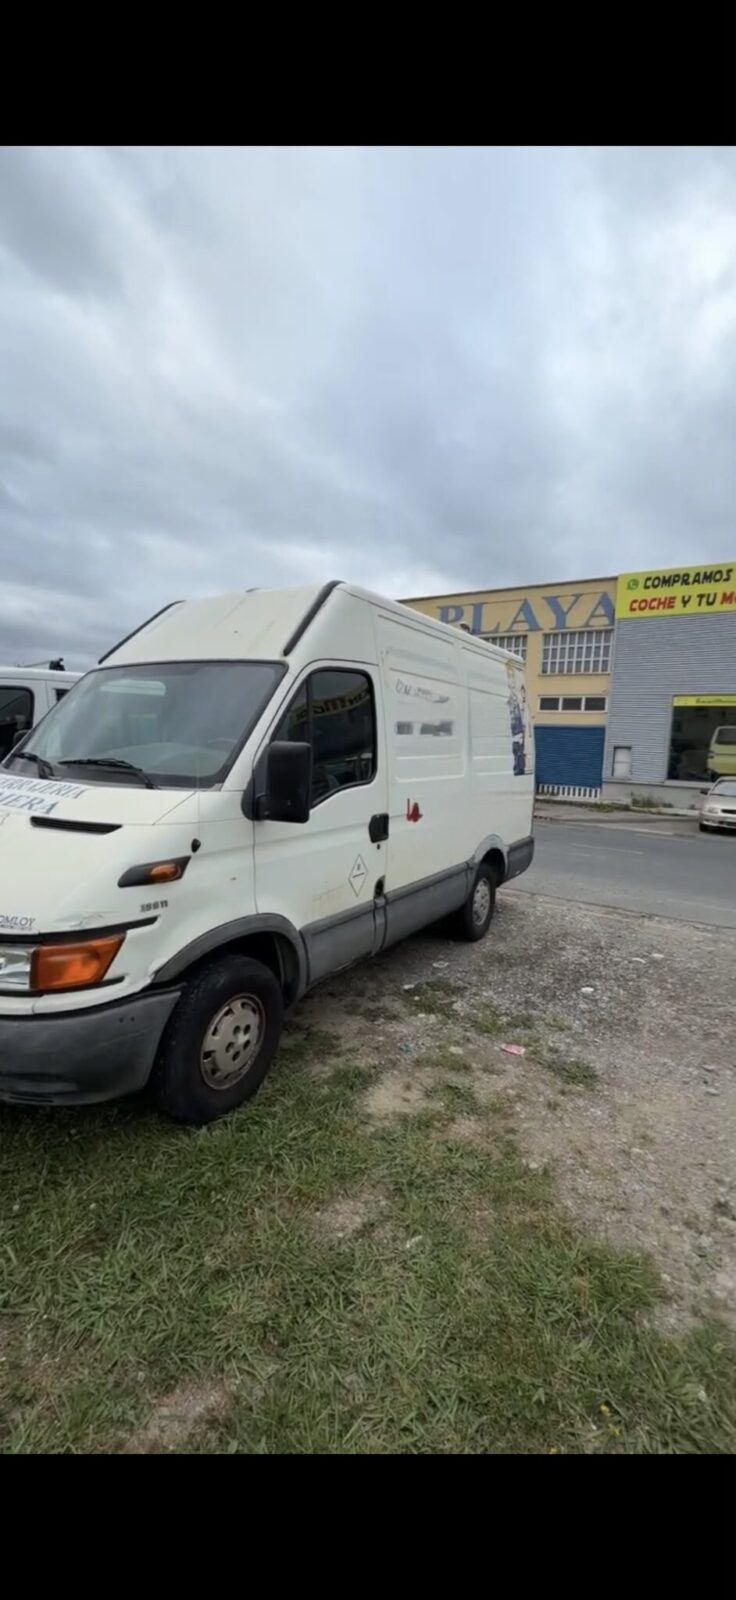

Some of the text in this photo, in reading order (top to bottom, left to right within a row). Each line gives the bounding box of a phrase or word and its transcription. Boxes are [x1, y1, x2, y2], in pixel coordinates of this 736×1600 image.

[643, 568, 734, 590] COMPRAMOS
[629, 596, 677, 612] COCHE
[681, 595, 692, 608] Y
[697, 592, 717, 607] TU
[437, 591, 615, 636] PLAYA
